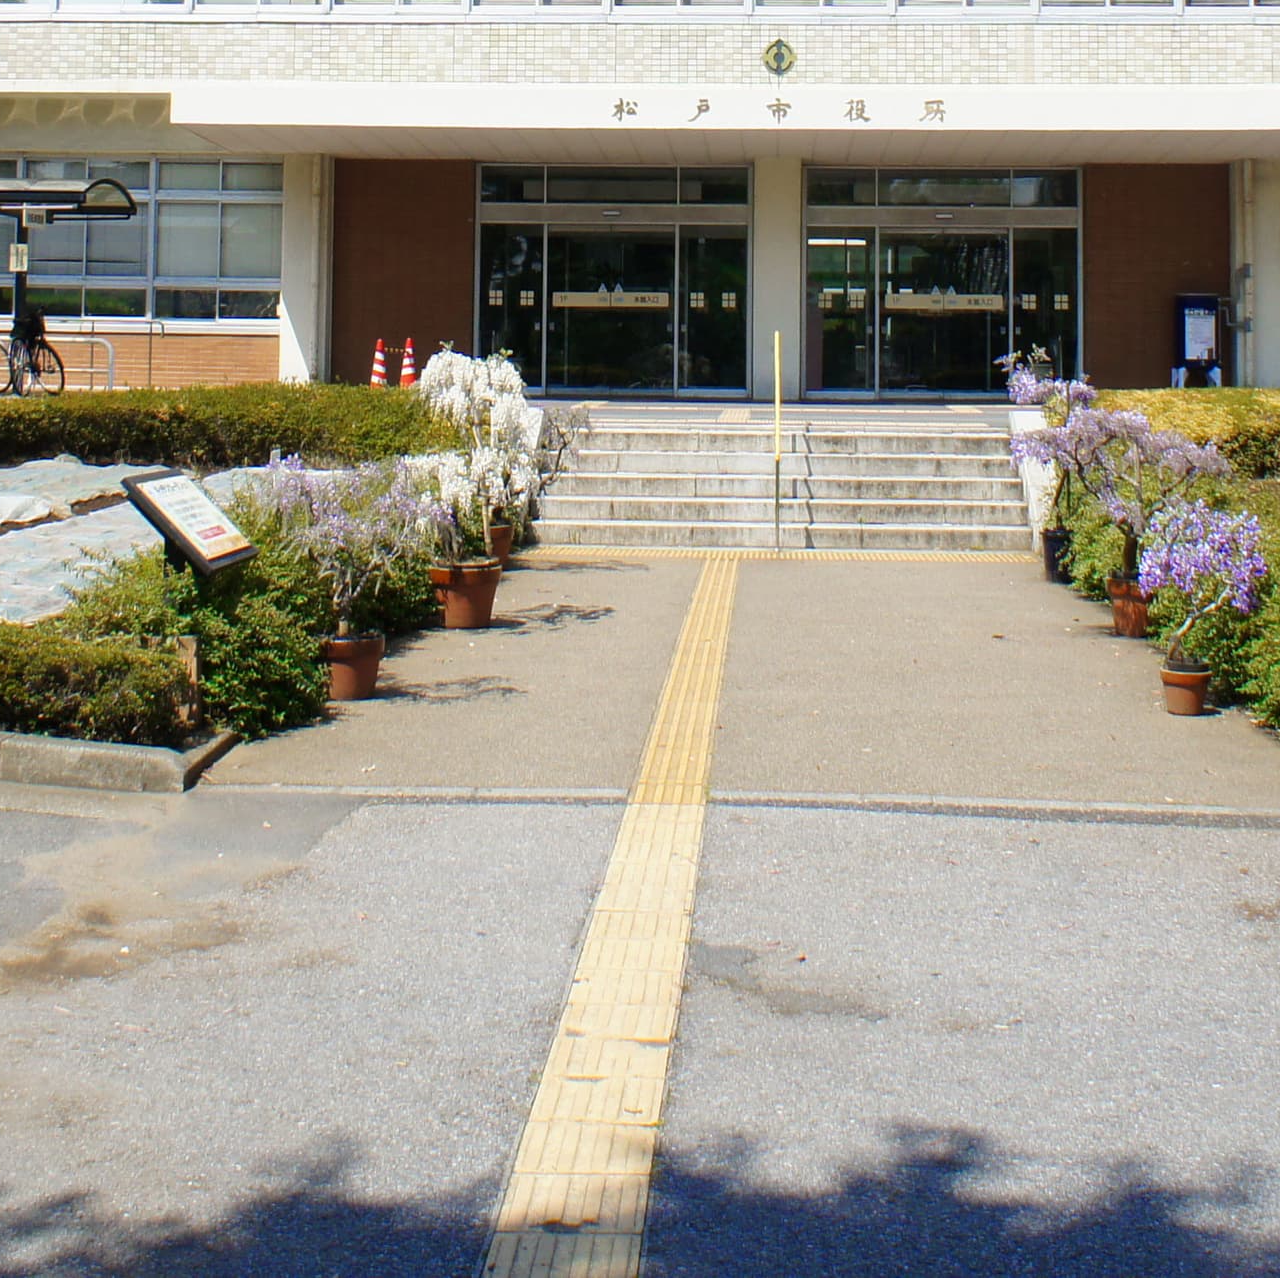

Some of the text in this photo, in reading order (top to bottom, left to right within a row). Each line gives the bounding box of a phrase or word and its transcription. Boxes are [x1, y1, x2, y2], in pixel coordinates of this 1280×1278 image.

[611, 97, 946, 124] 松戸市役所
